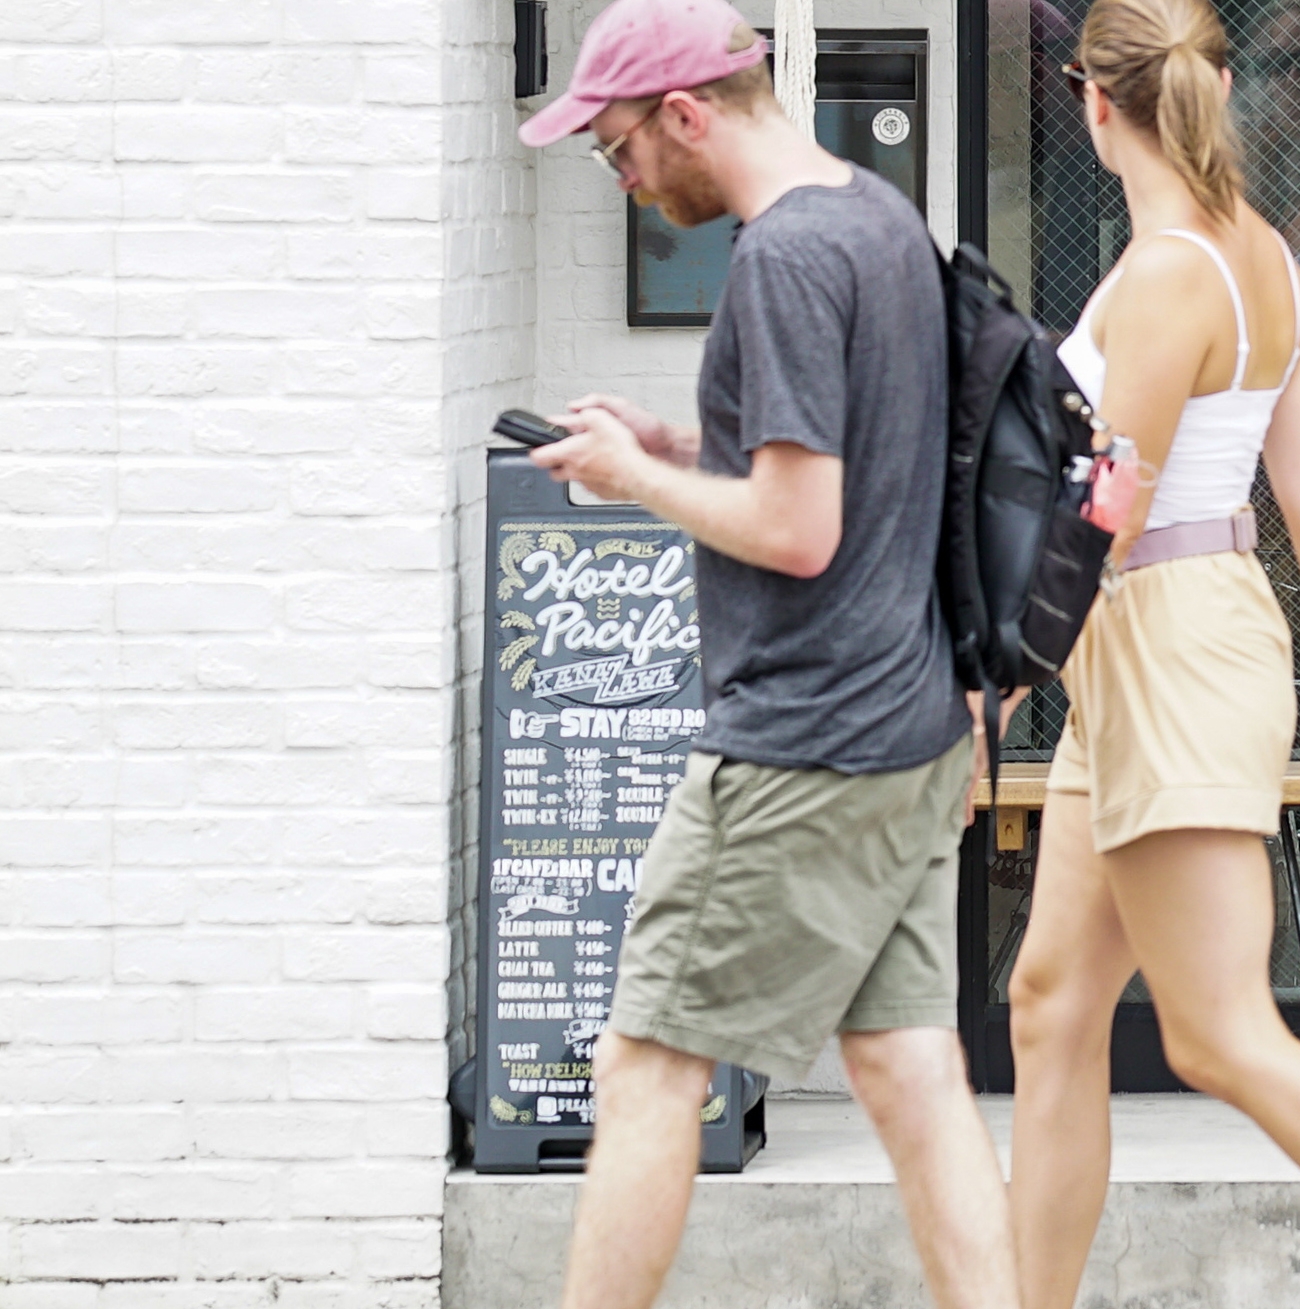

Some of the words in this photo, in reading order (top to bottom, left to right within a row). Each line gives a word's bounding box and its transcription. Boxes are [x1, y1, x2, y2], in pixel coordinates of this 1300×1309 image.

[521, 545, 693, 601] Hotel
[535, 598, 701, 667] Pacific
[560, 708, 628, 738] STAY
[573, 838, 619, 855] ENJOY
[499, 941, 540, 957] LATTE
[498, 961, 529, 977] CHAI
[531, 961, 555, 977] TEA
[498, 1043, 541, 1060] TOAST
